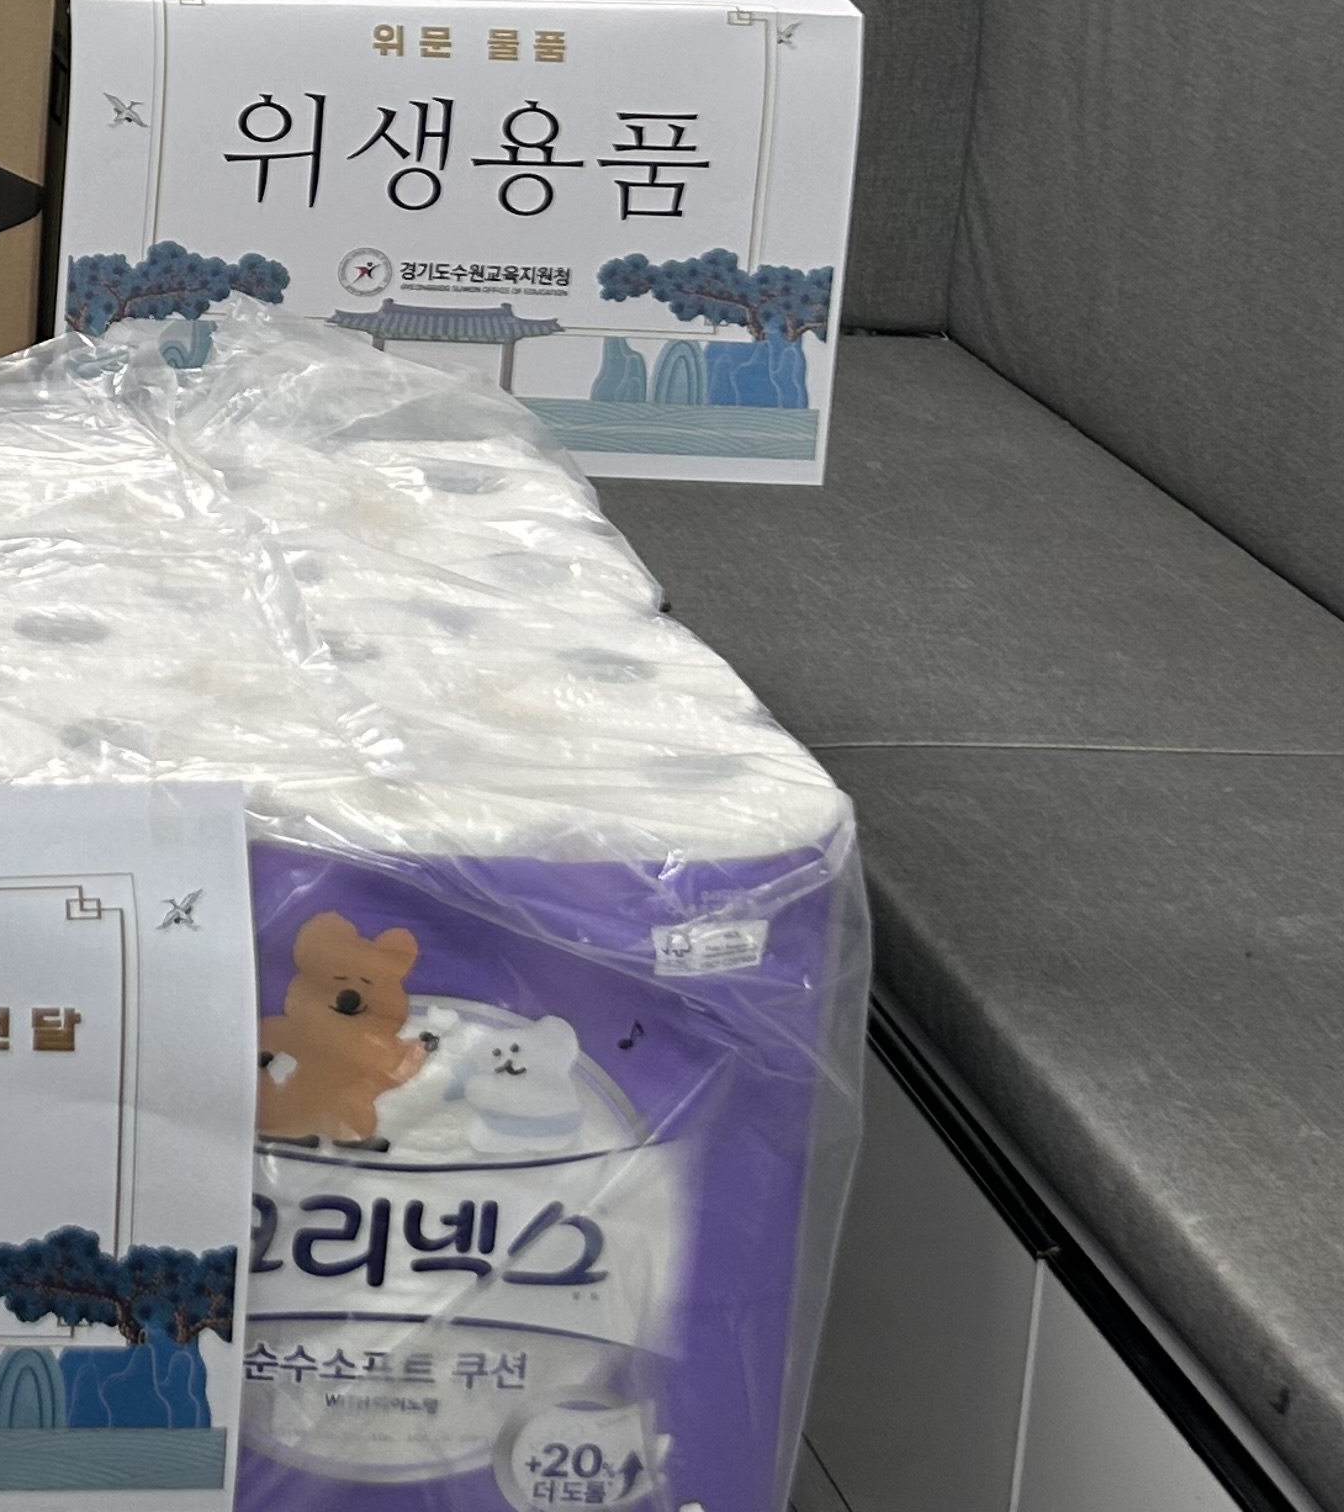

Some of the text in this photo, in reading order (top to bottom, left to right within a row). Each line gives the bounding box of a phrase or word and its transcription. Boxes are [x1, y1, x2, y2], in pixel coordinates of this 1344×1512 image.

[372, 23, 568, 63] 위문 물품
[223, 92, 711, 221] 위생용품
[400, 262, 571, 287] 경기도수원교육지원청
[243, 1343, 528, 1390] 순수소프트 쿠션
[533, 1480, 555, 1503] 더
